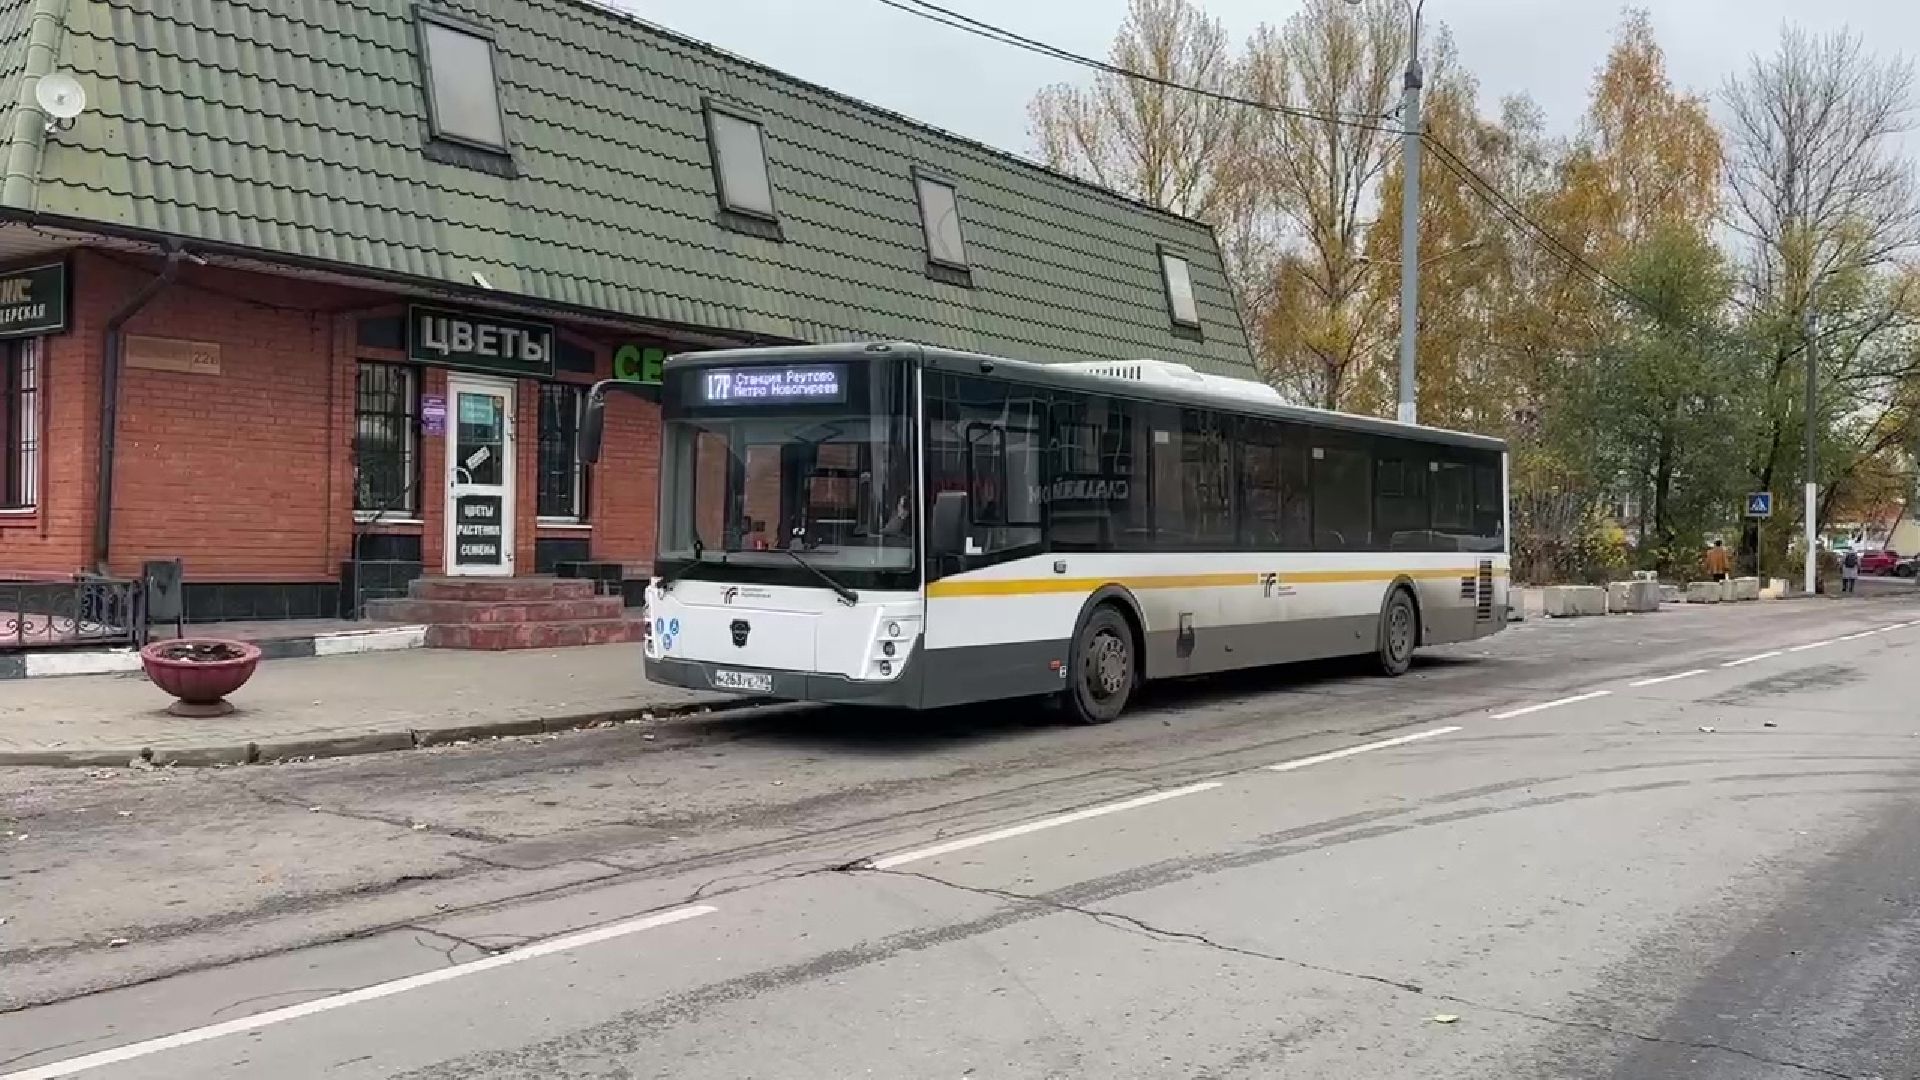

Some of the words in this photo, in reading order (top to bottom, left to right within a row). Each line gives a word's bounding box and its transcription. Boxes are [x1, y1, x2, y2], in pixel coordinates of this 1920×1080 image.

[424, 315, 550, 362] ЦВЕТЫ
[736, 372, 782, 385] Станция
[734, 385, 767, 397] Метро
[464, 504, 494, 517] ЦВЕТЫ
